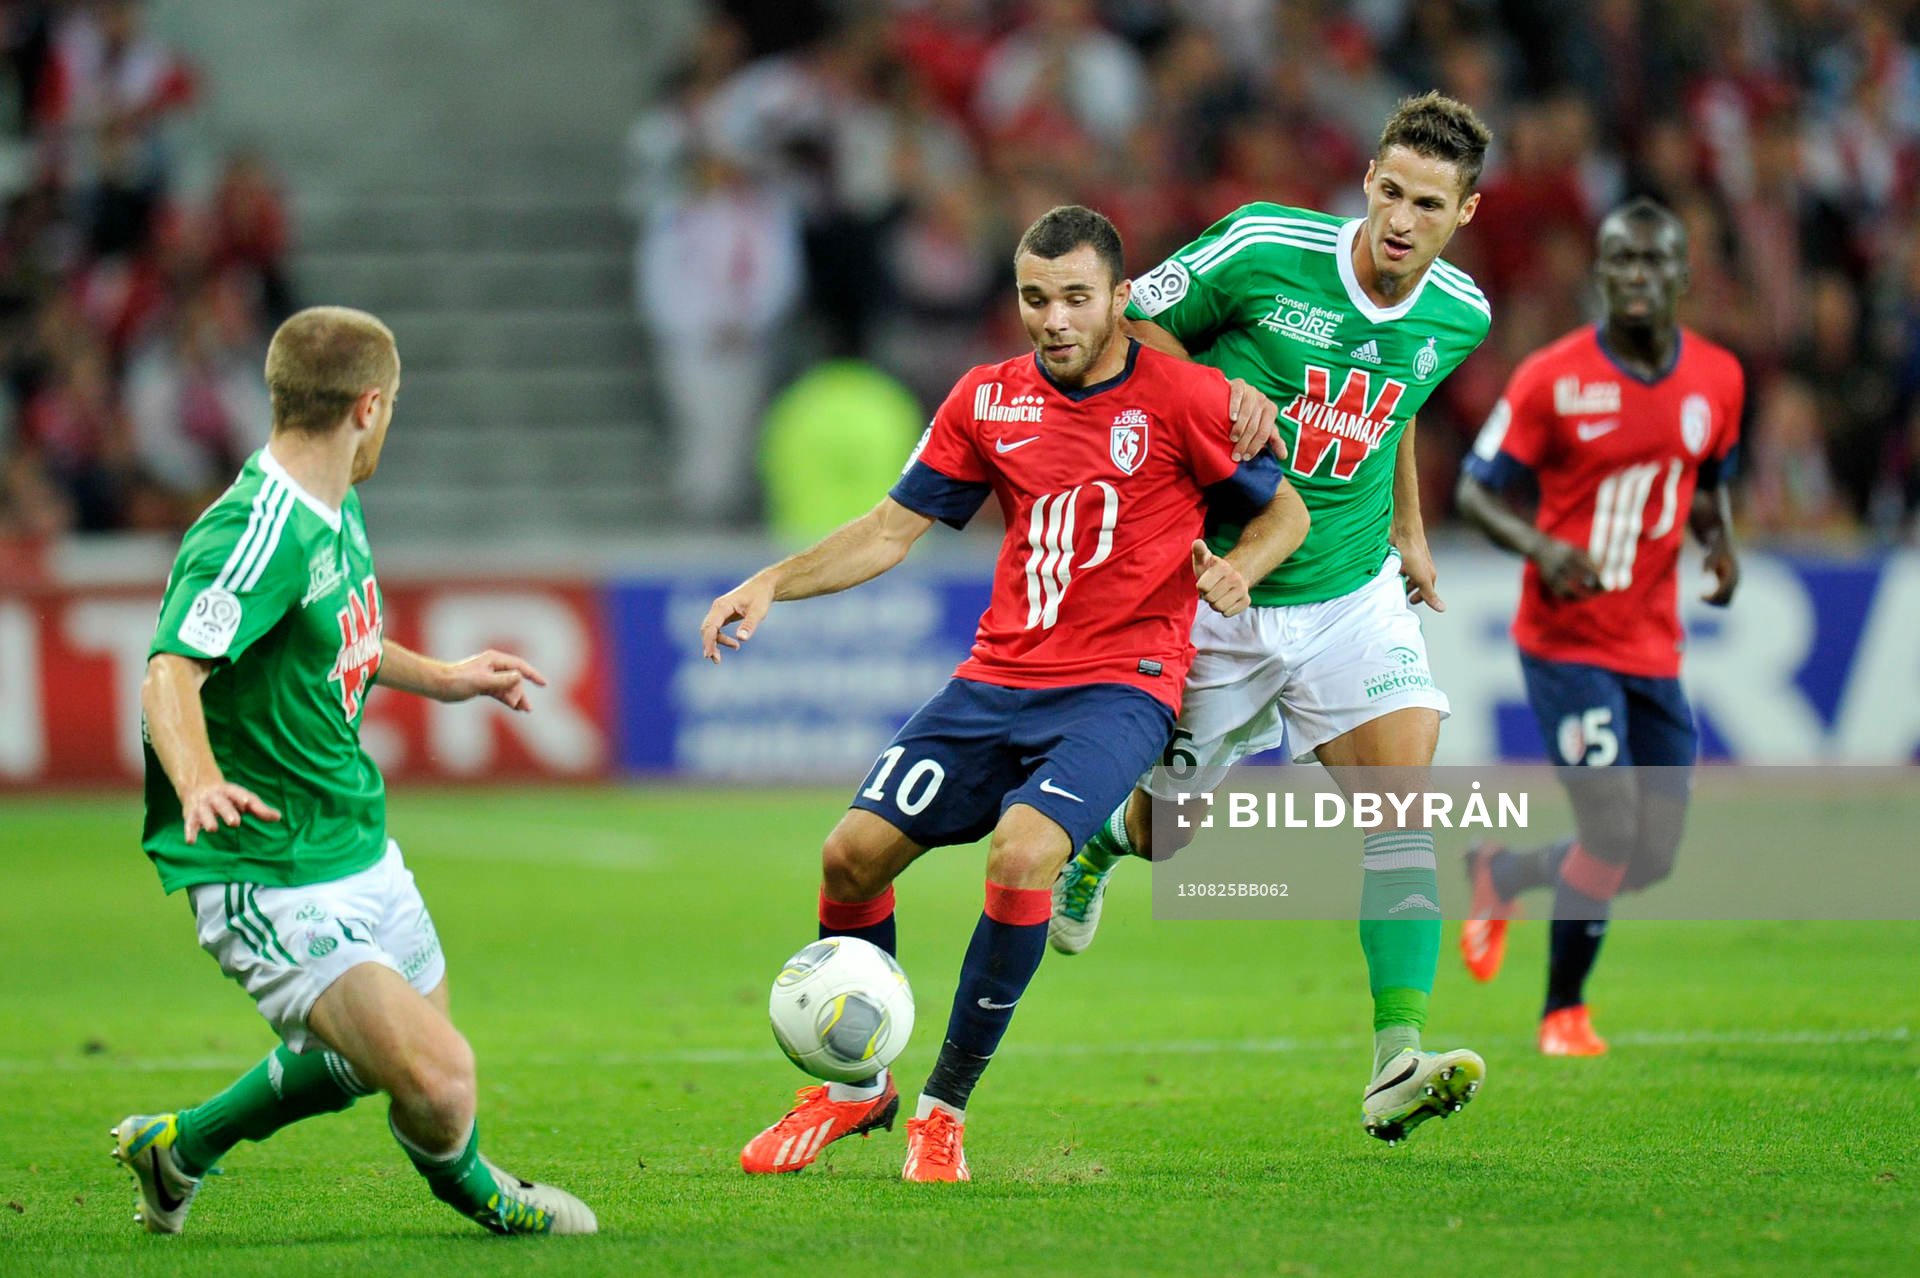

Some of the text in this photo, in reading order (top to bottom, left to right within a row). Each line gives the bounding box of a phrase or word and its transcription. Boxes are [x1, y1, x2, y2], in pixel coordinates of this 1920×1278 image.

[1273, 305, 1337, 338] LOIRE
[1275, 293, 1344, 323] Conseil général
[1350, 349, 1381, 365] adidas
[1113, 414, 1148, 425] LOSC
[1297, 398, 1384, 446] WINAMAX
[1163, 729, 1197, 780] 6
[1582, 708, 1618, 767] 5
[863, 745, 945, 816] 10
